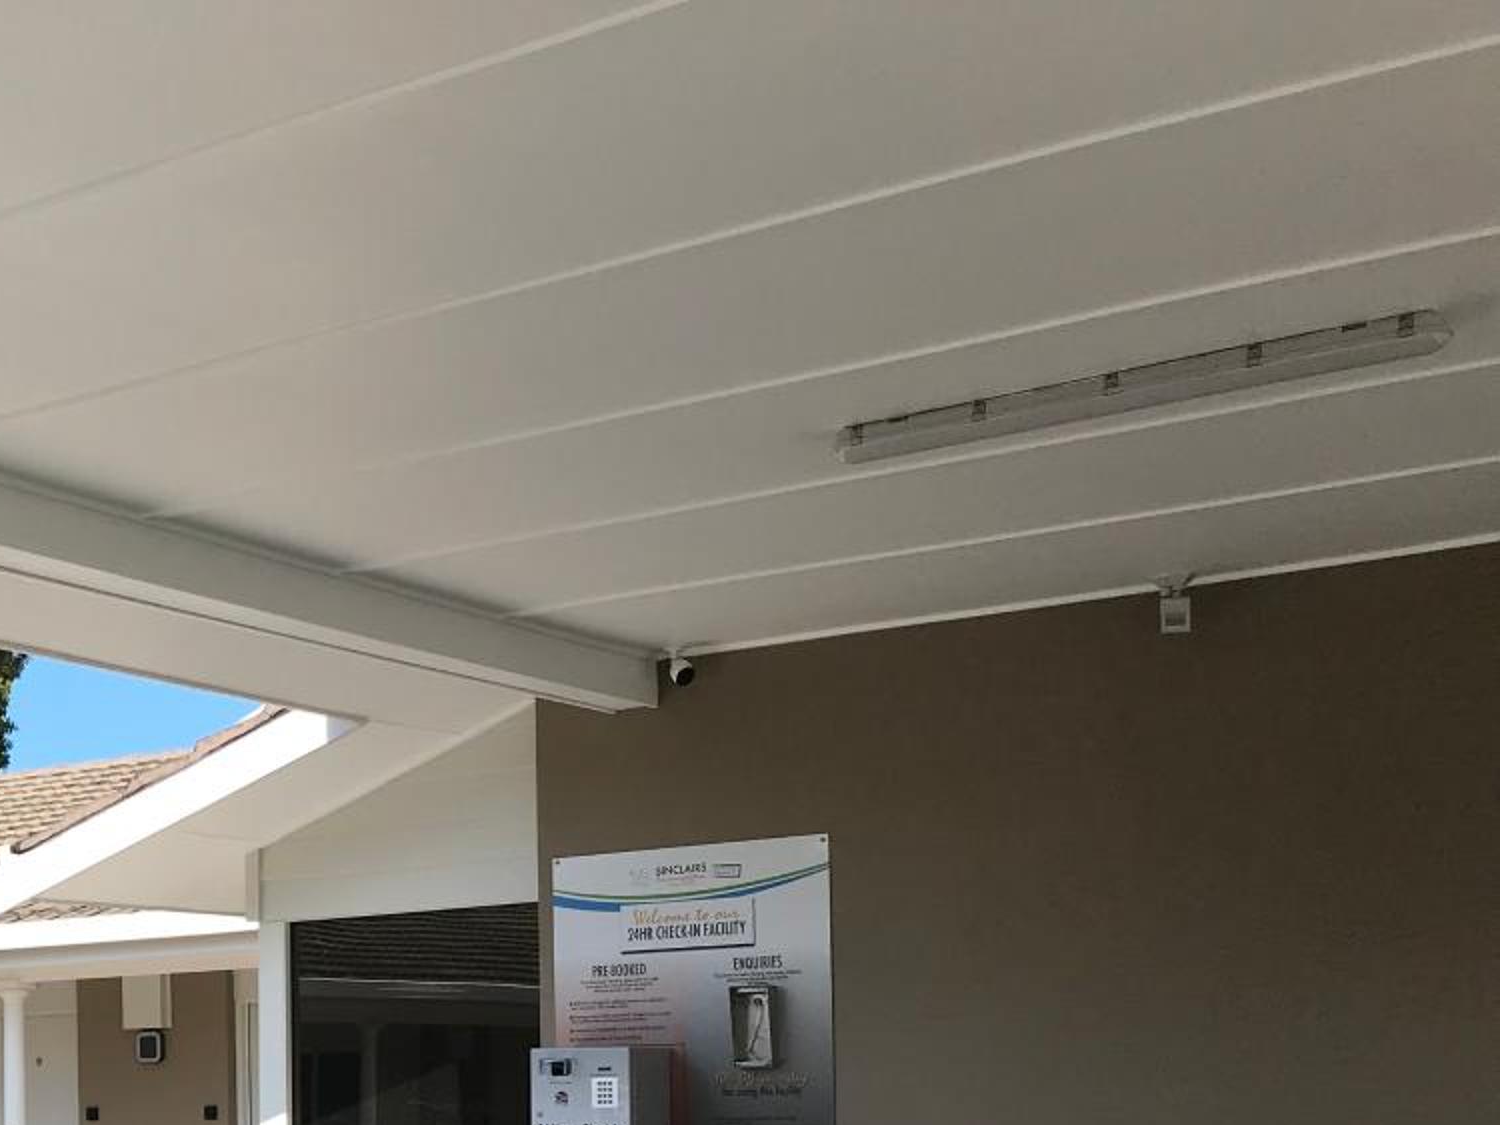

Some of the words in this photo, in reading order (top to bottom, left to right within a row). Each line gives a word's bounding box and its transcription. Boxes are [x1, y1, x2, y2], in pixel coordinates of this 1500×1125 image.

[656, 862, 707, 877] SINCLAIRS
[627, 927, 653, 941] 24HR
[703, 920, 747, 936] FACILITY
[732, 954, 783, 970] ENQUIRIES
